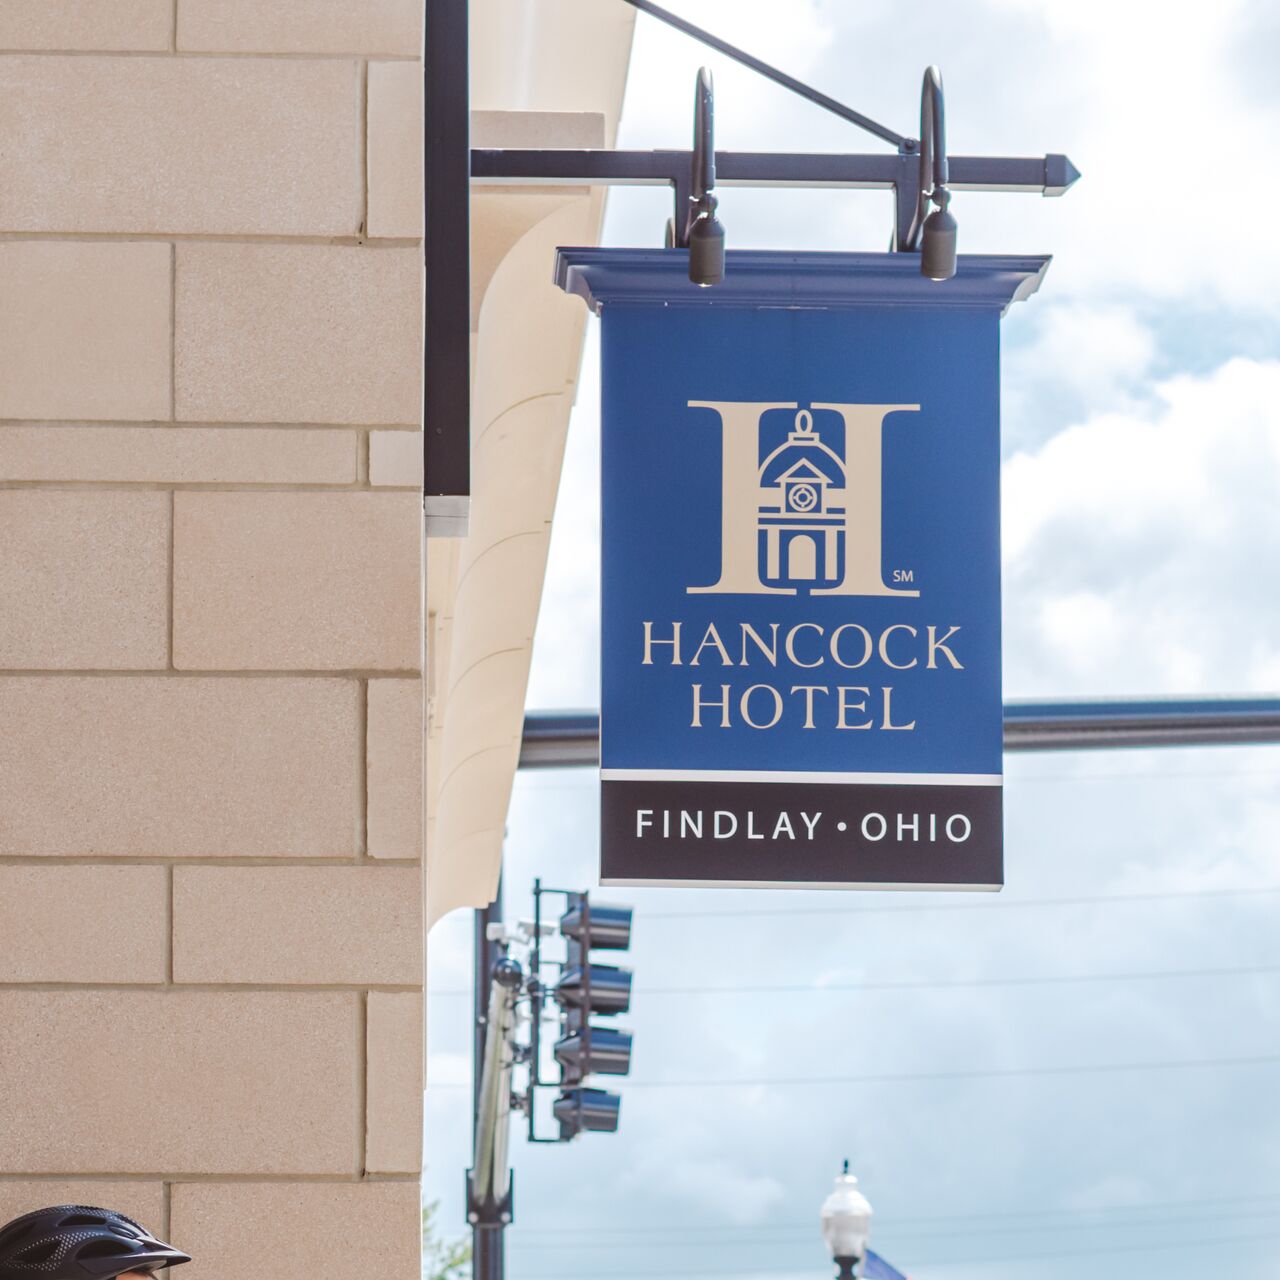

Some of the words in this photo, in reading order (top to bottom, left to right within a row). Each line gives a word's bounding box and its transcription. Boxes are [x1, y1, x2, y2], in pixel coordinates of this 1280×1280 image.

[893, 569, 914, 582] SM
[641, 621, 964, 670] HANCOCK
[690, 684, 916, 731] HOTEL
[636, 809, 822, 840] FINDLAY
[861, 812, 972, 843] OHIO
